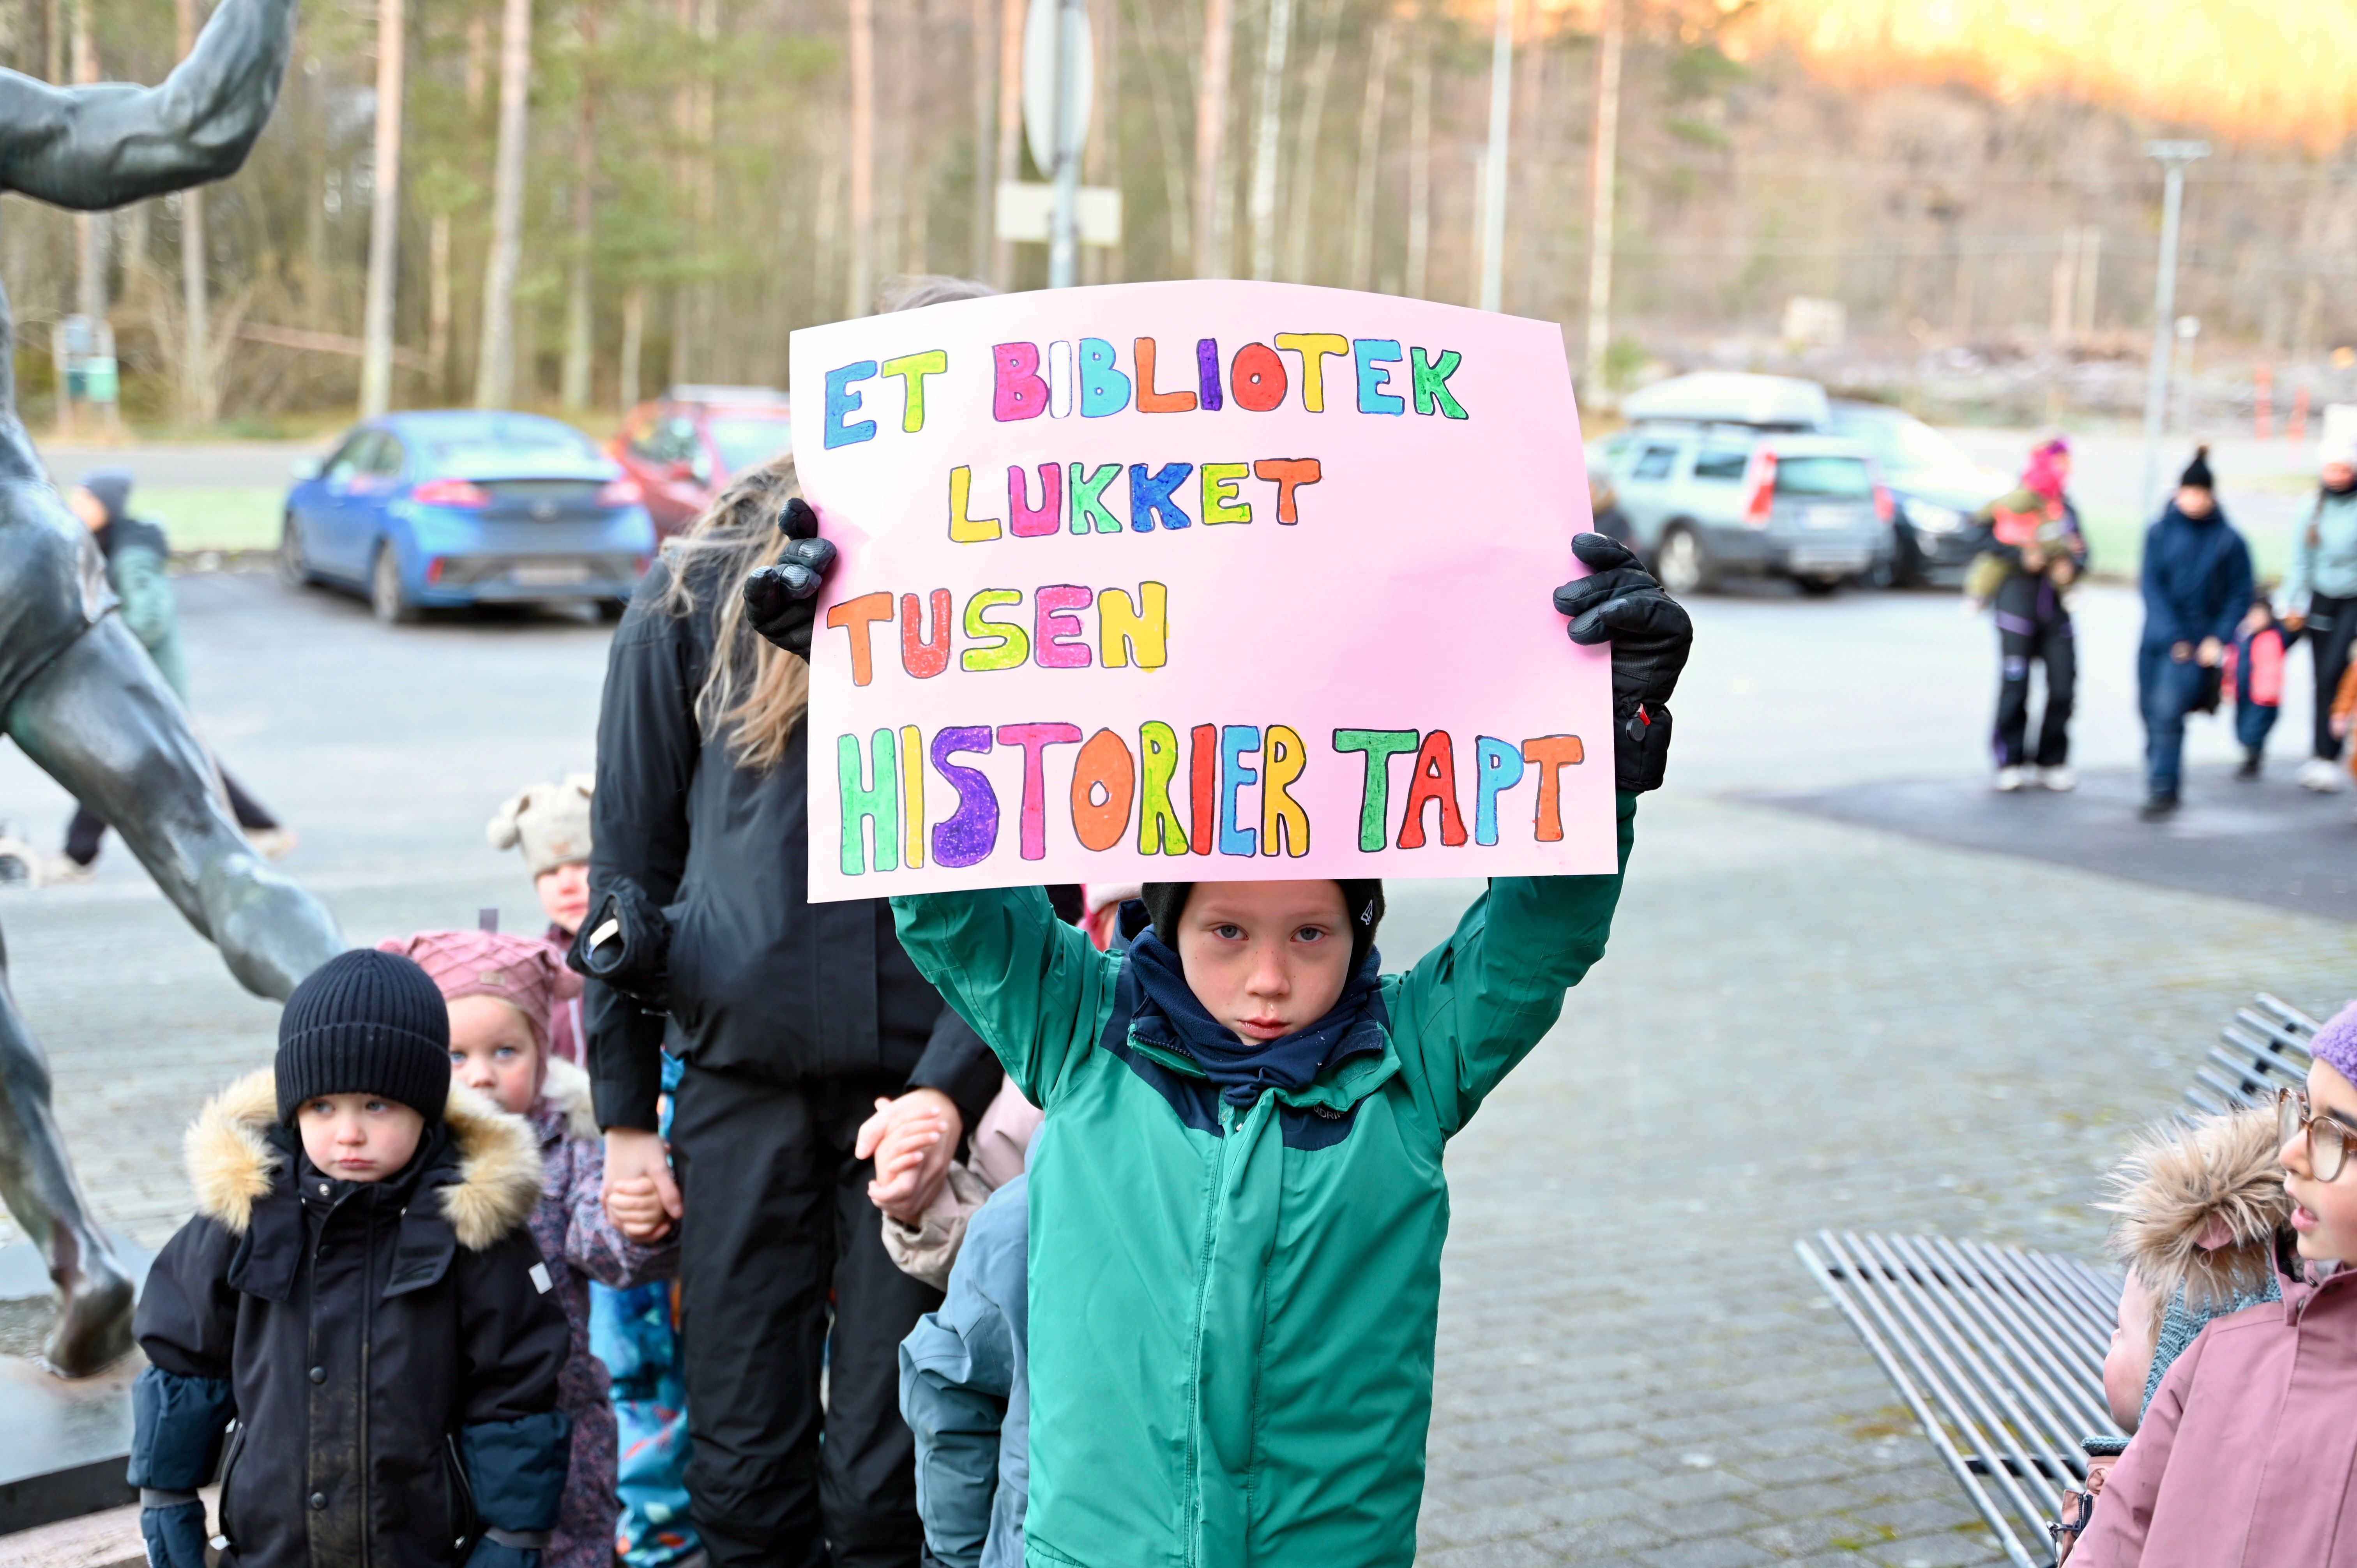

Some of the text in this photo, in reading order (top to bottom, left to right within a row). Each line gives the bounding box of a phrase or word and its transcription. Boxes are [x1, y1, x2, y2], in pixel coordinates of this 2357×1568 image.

[823, 332, 1469, 450] ET BIBLIOTEK
[948, 457, 1322, 544] LUKKET
[827, 581, 1169, 687] TUSEN
[836, 720, 1585, 876] HISTORIER TAPT
